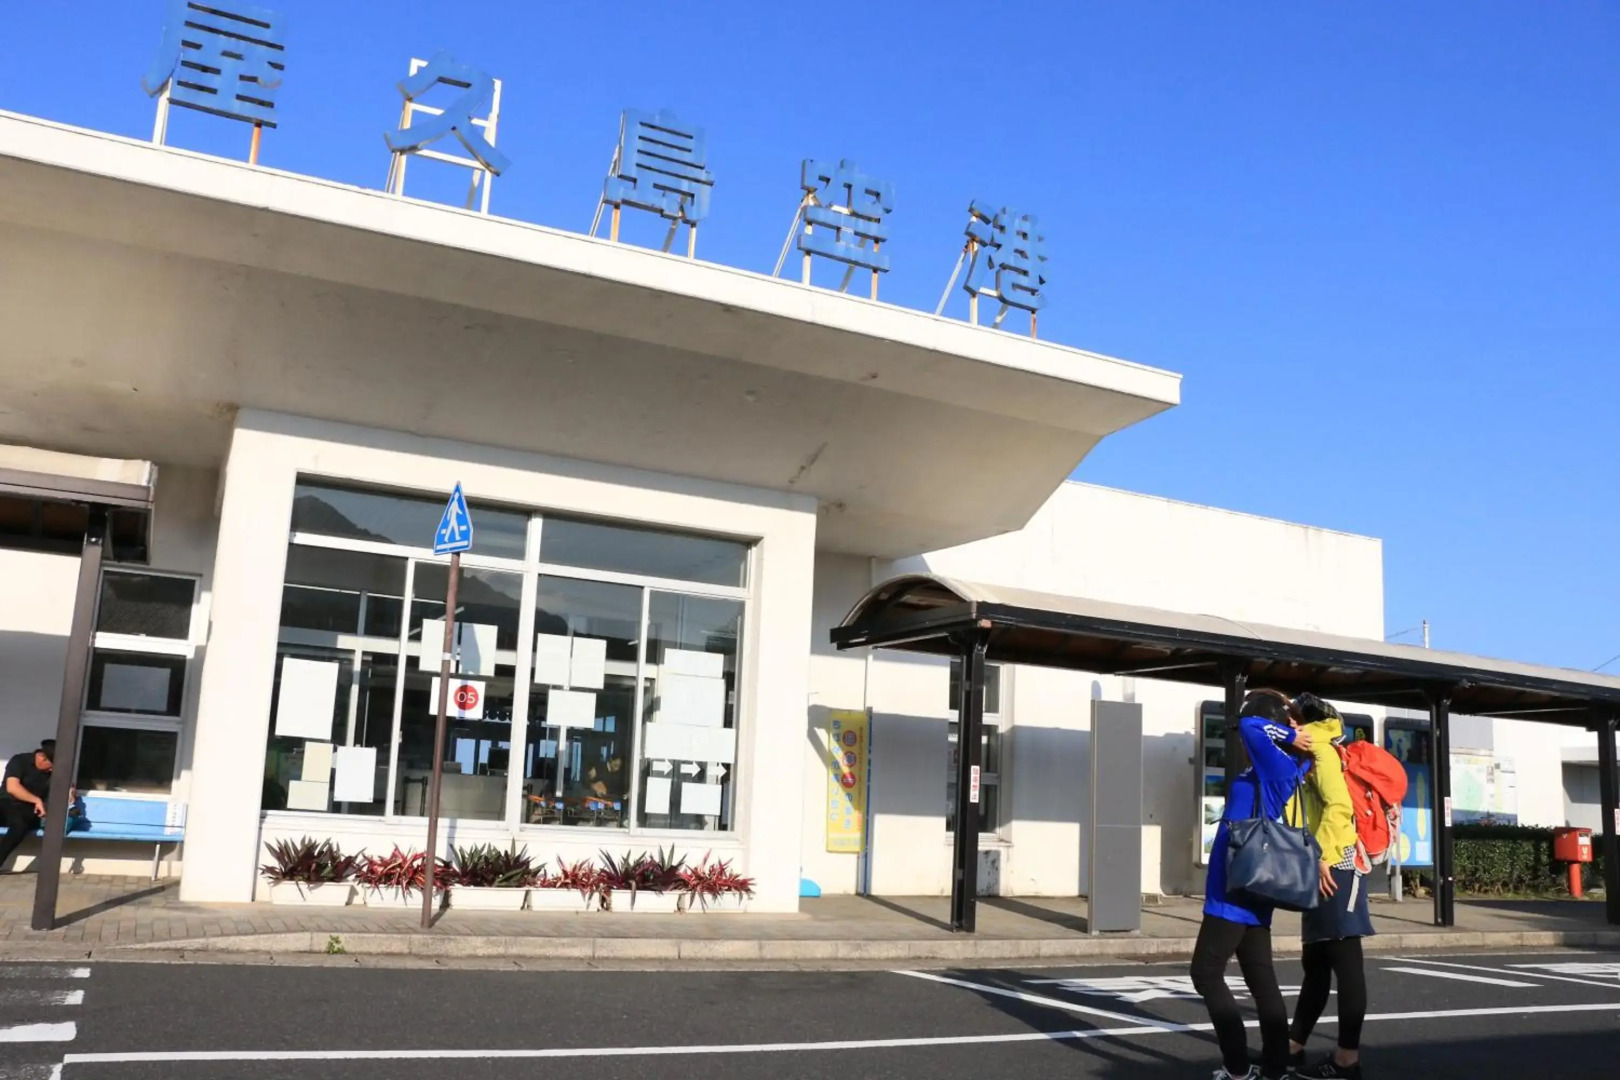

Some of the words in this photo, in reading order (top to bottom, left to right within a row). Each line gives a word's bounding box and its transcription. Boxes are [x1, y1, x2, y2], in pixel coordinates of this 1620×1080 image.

[141, 0, 1048, 311] 屋久島空港
[457, 691, 476, 704] 05
